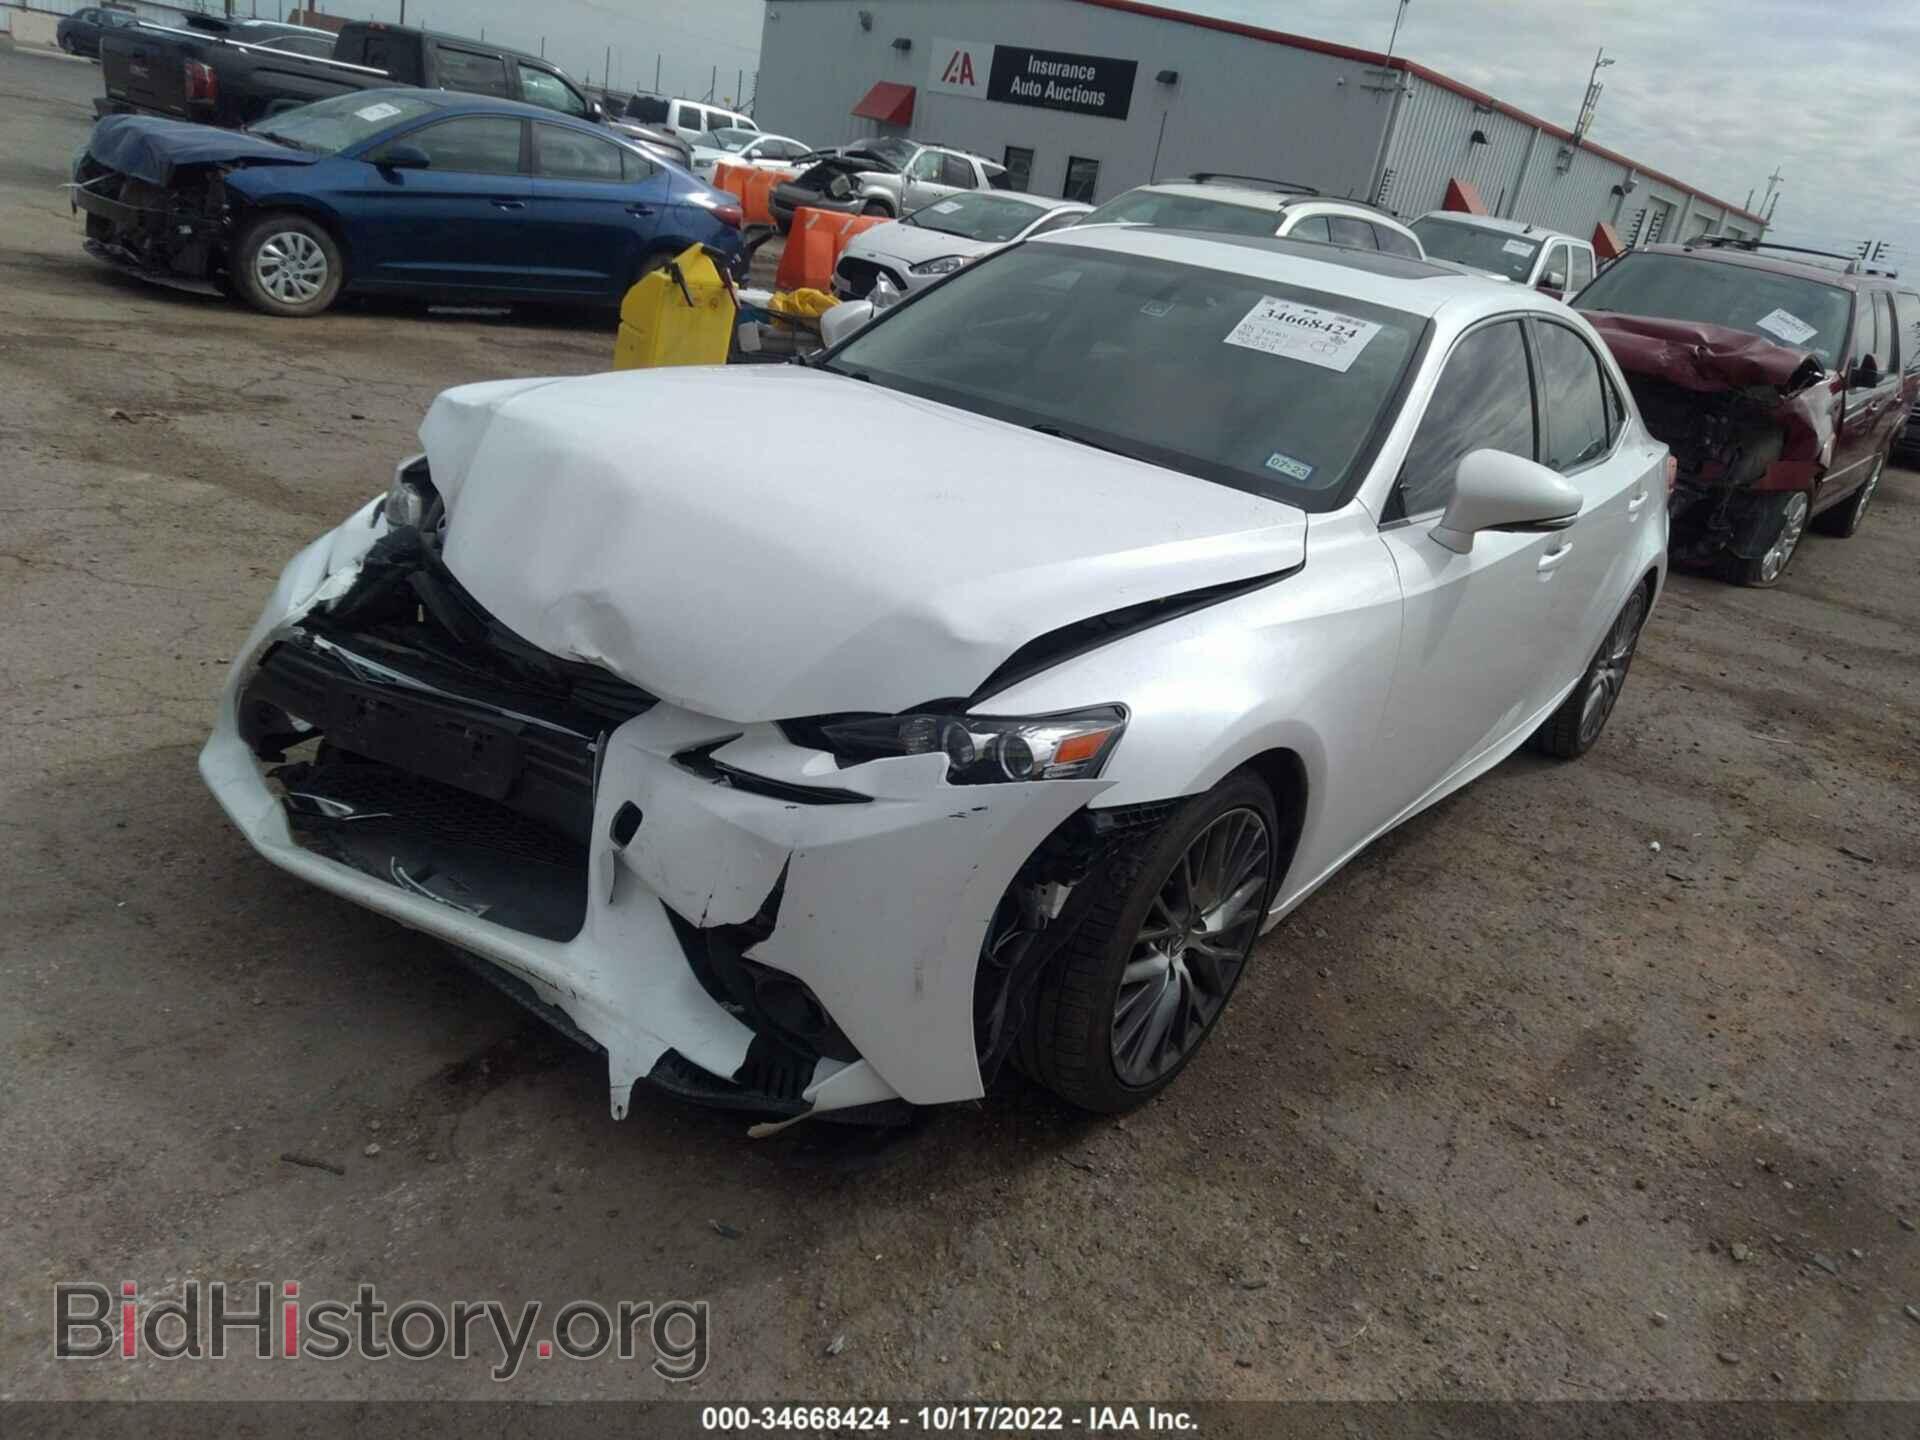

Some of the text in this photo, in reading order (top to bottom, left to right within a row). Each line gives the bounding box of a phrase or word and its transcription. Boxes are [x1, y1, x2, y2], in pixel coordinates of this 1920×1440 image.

[1027, 54, 1096, 81] Insurance
[1010, 76, 1105, 106] Auto Auctions
[1262, 308, 1357, 338] 34668424
